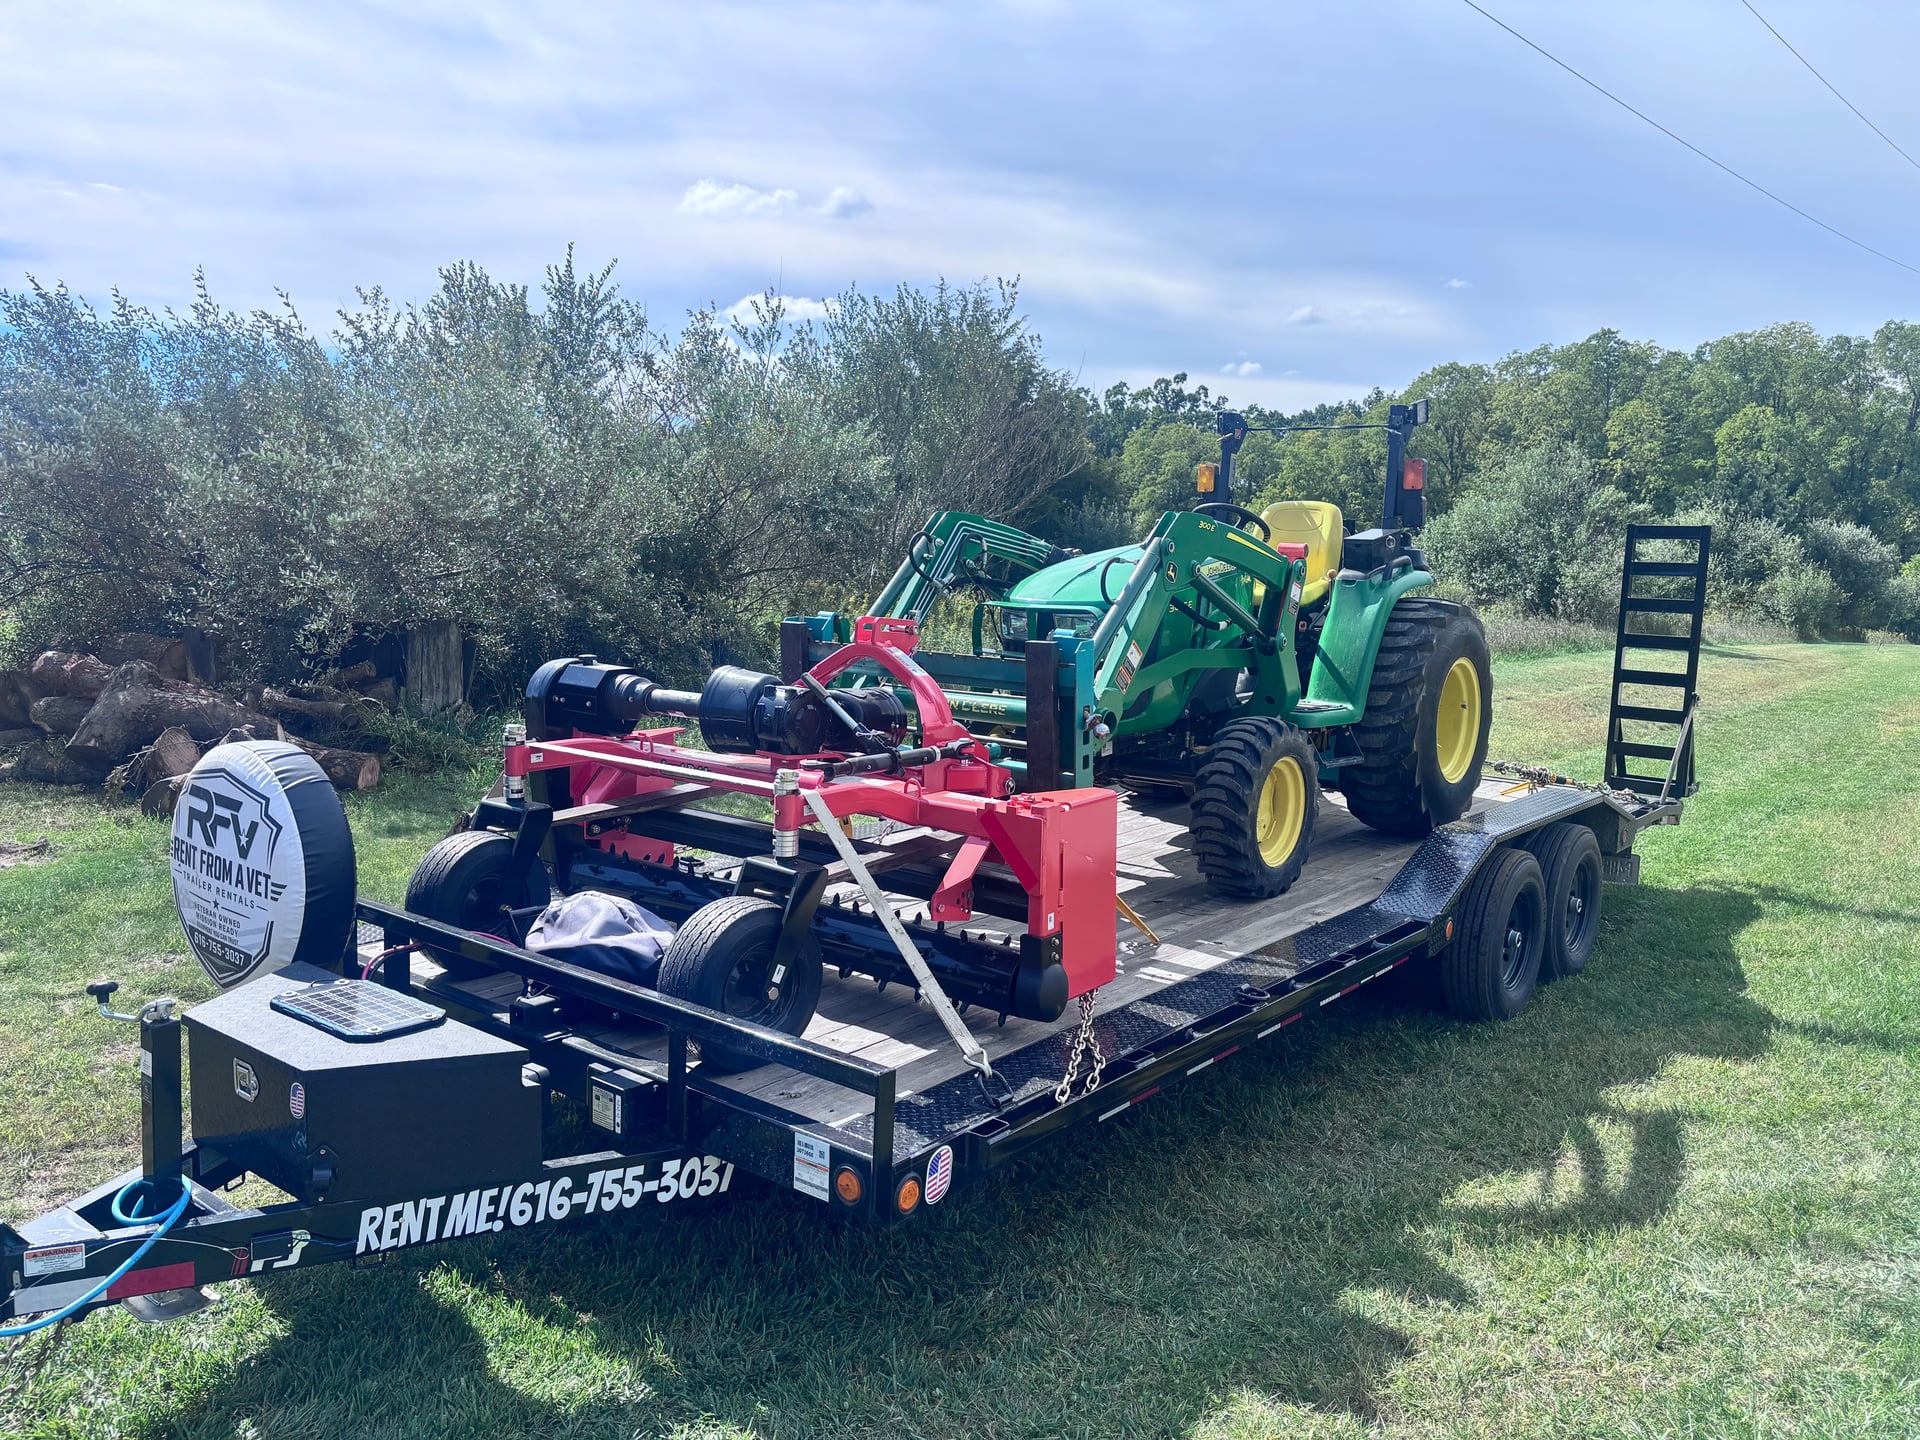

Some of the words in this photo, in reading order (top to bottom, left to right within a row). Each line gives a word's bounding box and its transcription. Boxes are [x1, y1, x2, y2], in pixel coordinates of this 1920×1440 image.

[187, 784, 260, 860] RFV
[173, 836, 198, 870] RENT
[199, 849, 233, 886] FROM
[234, 863, 244, 890] A
[246, 866, 271, 900] VET
[183, 870, 212, 893] TRAILER
[215, 886, 255, 909] RENTALS
[218, 913, 241, 929] OWNED
[218, 922, 239, 938] READY
[194, 931, 245, 967] 616-755-3037
[355, 1196, 447, 1256] RENT
[41, 1246, 77, 1257] WARNING
